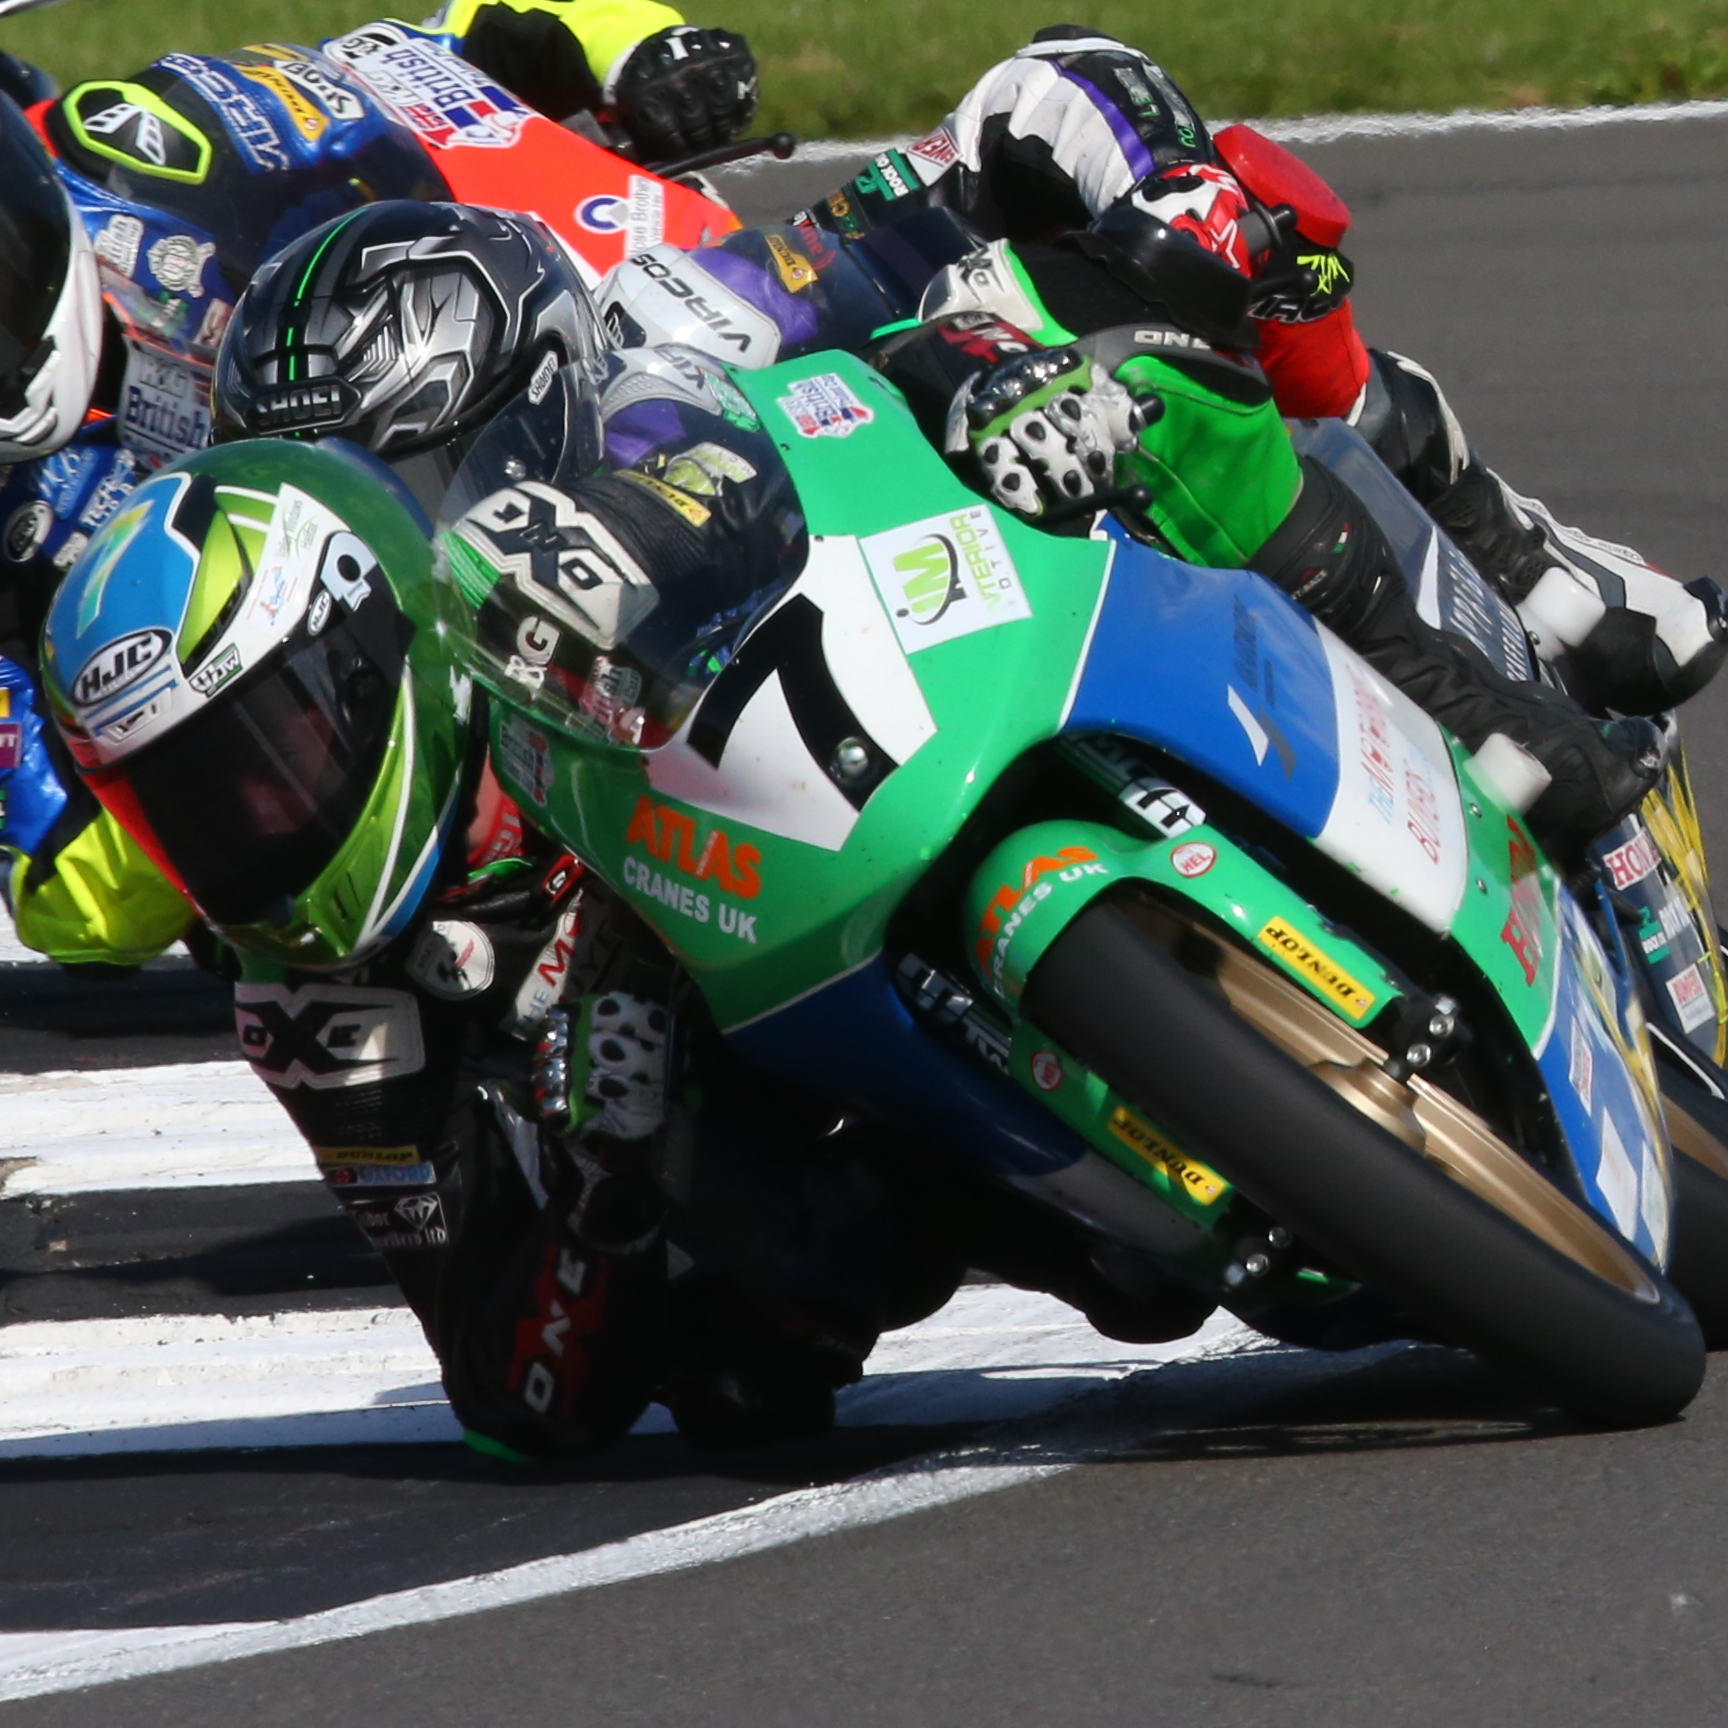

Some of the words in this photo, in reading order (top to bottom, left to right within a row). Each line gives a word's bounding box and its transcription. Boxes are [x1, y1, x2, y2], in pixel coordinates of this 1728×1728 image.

[381, 49, 476, 109] British
[879, 165, 909, 198] ROCK
[629, 253, 752, 353] VIRCOS
[531, 357, 557, 400] SHOEI
[127, 385, 210, 450] British
[970, 510, 1017, 608] OTIVE
[312, 591, 329, 630] HJC
[80, 633, 154, 701] HJC
[687, 592, 901, 813] 7
[626, 795, 762, 899] ATLAS
[1179, 850, 1214, 874] HEL
[624, 856, 710, 924] CRANES
[718, 902, 758, 945] UK
[977, 845, 1097, 981] ATLAS
[992, 882, 1053, 999] CRANES
[1058, 861, 1110, 882] UK
[1264, 924, 1357, 1000] DUNLOP
[1113, 1114, 1206, 1187] DUNLOP
[524, 1246, 588, 1416] ONE
